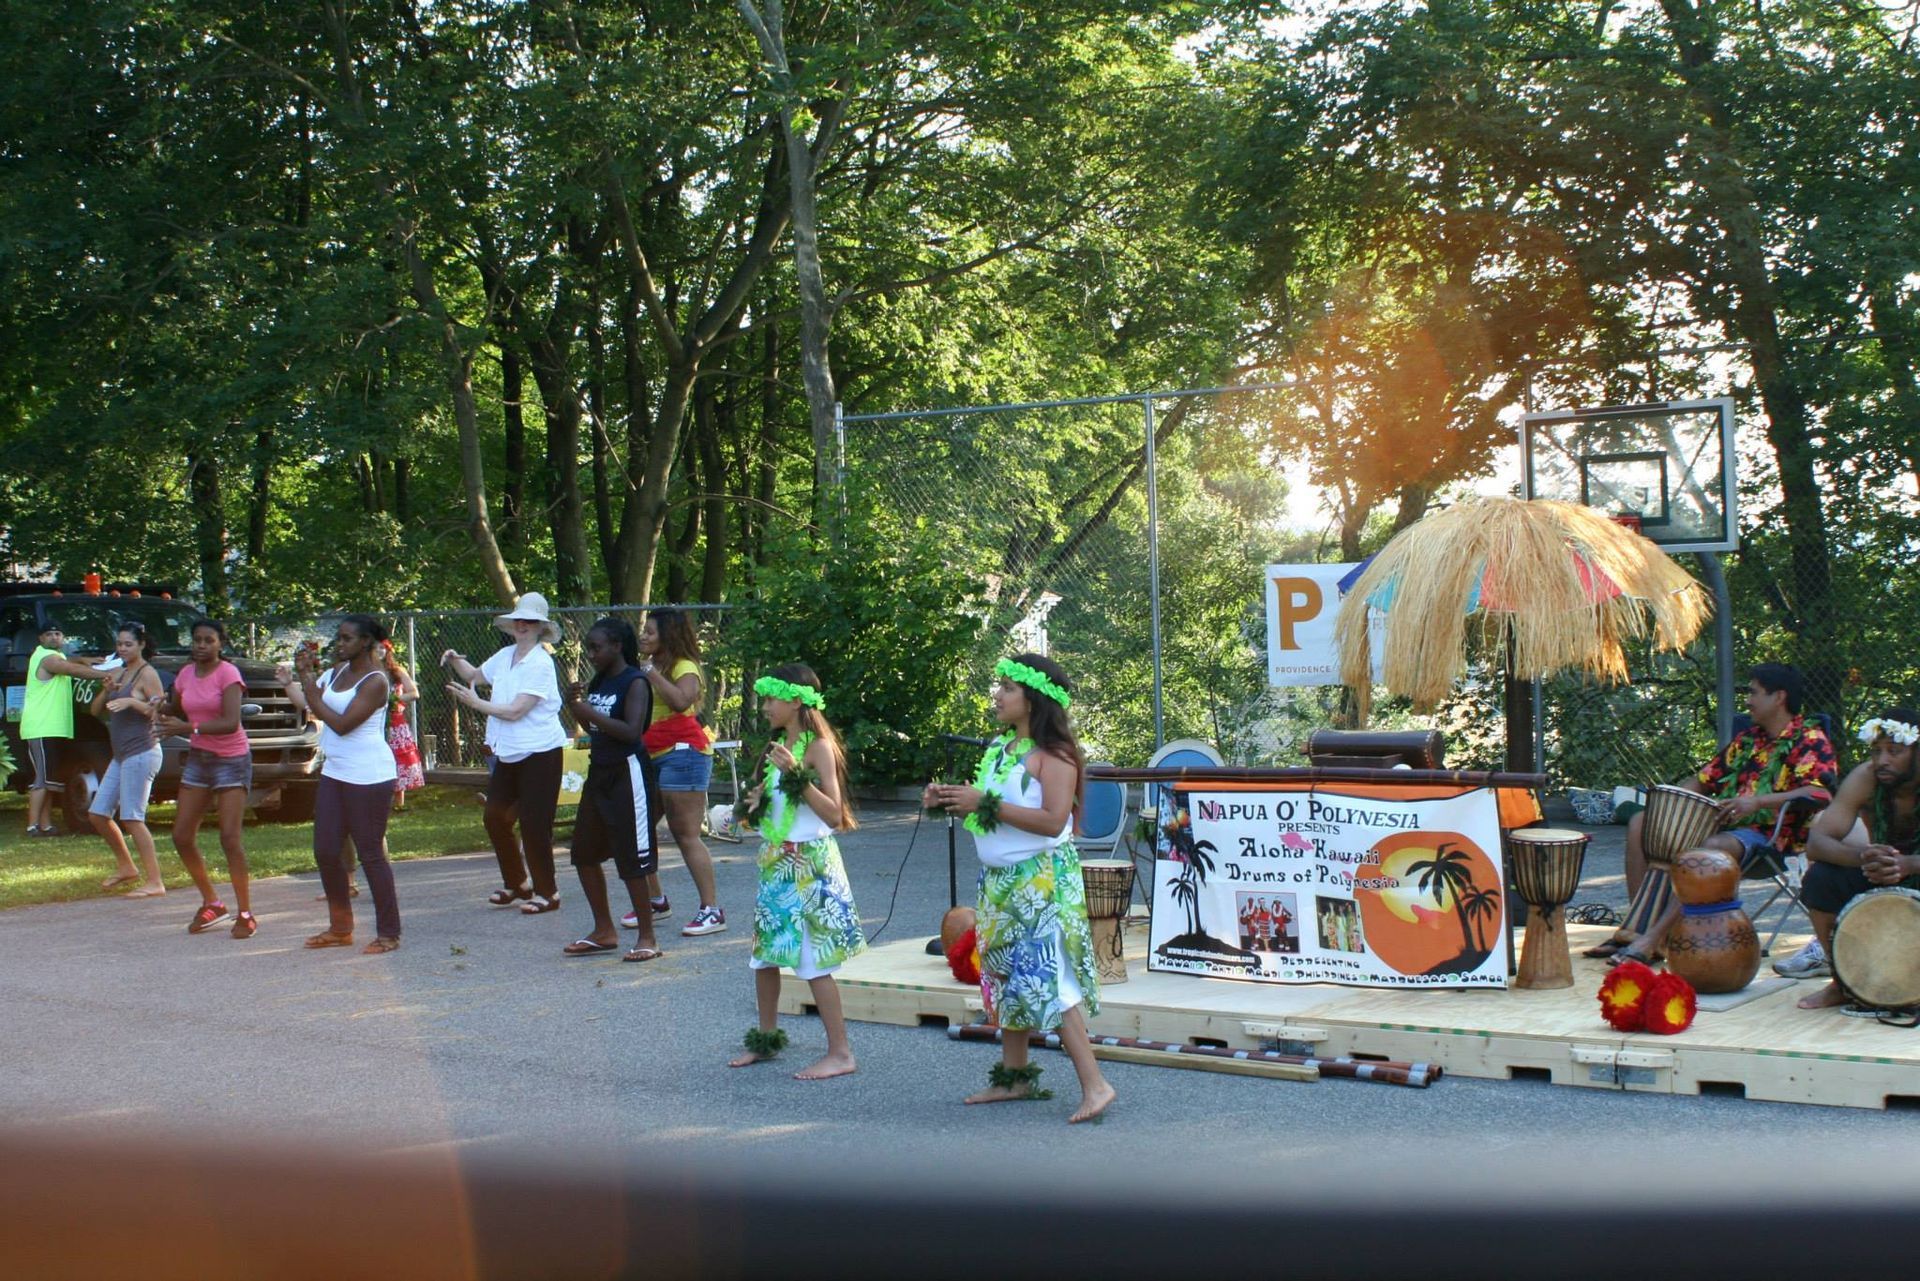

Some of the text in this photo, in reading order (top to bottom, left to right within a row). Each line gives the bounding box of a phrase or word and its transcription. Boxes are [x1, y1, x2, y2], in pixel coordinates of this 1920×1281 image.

[1272, 577, 1323, 650] P
[1199, 800, 1268, 820] NAPUA
[1308, 800, 1420, 829] POLYNESIA
[1278, 822, 1340, 835] PRESENTS
[1239, 837, 1304, 858] Aloha
[1225, 863, 1400, 891] Drums of Polynesia
